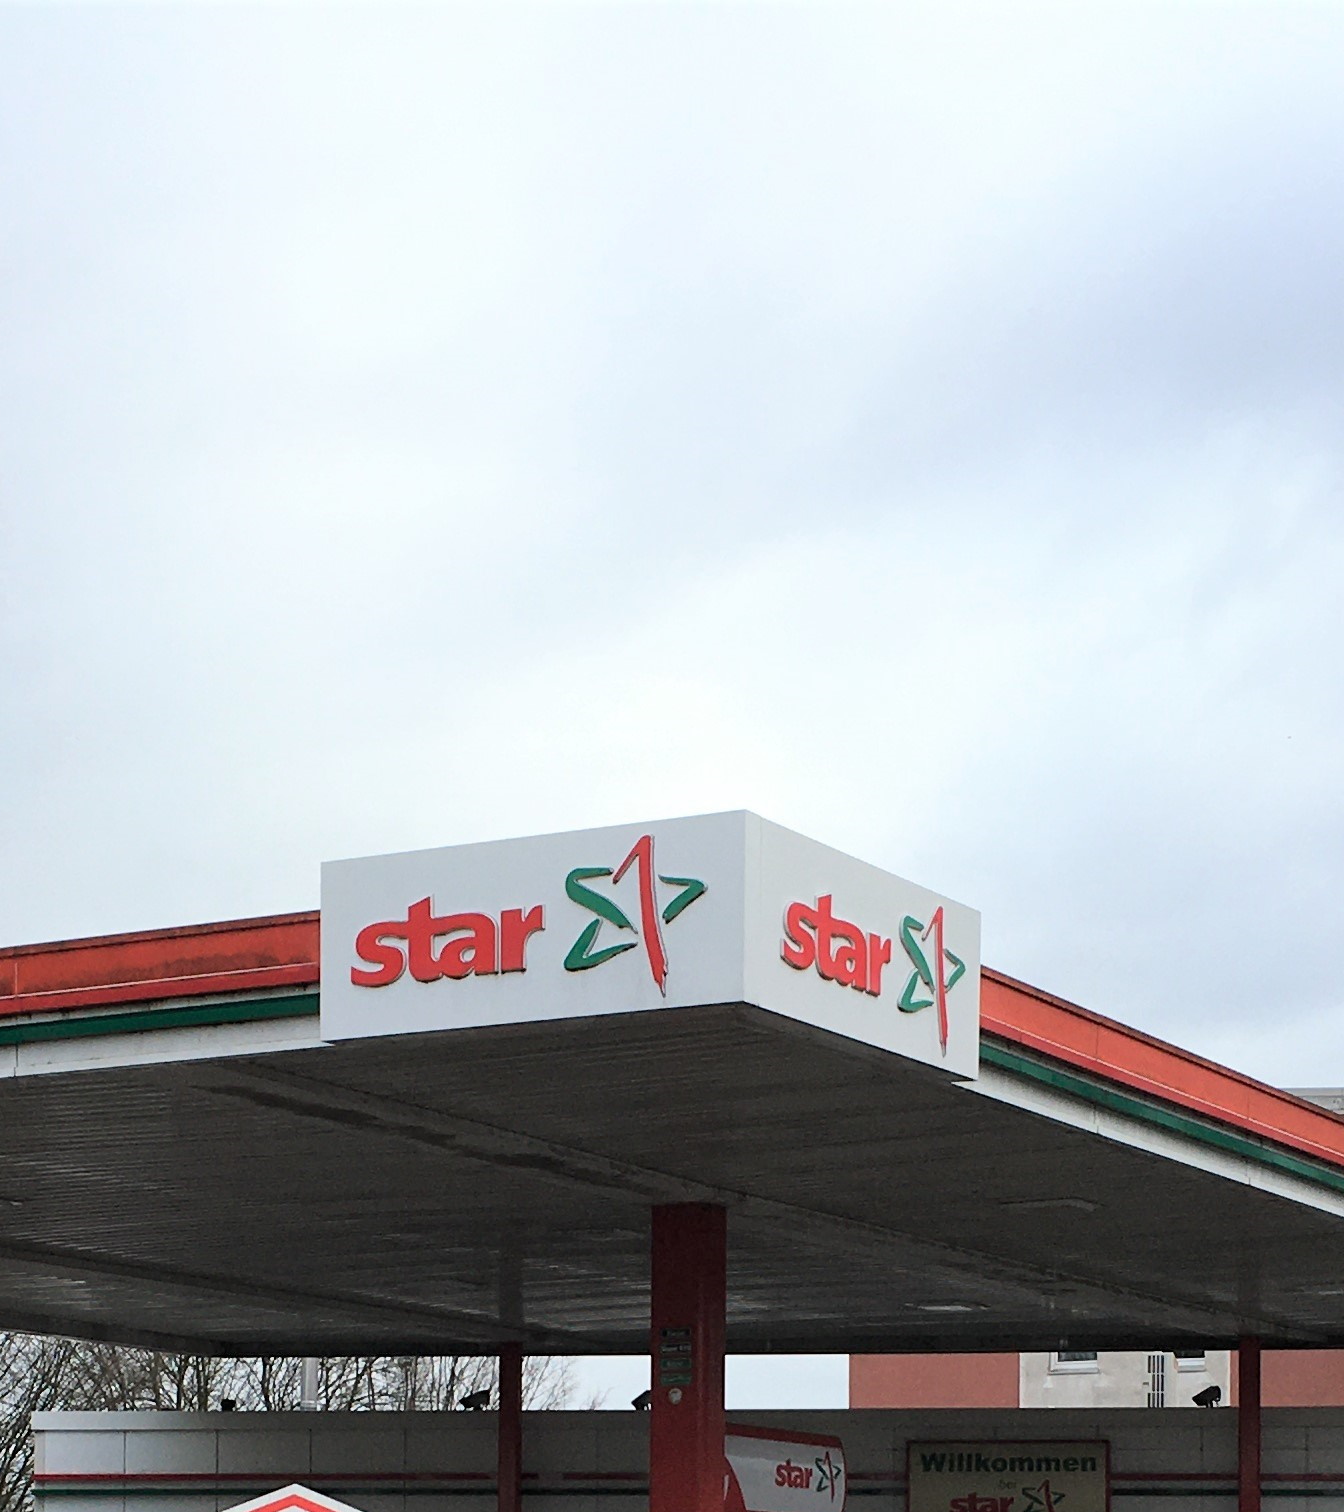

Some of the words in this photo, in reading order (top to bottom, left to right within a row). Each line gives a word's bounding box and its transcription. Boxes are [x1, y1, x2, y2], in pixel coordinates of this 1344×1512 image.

[350, 895, 546, 988] star
[780, 894, 892, 997] star
[774, 1459, 812, 1490] star
[920, 1453, 1097, 1472] Willkommen
